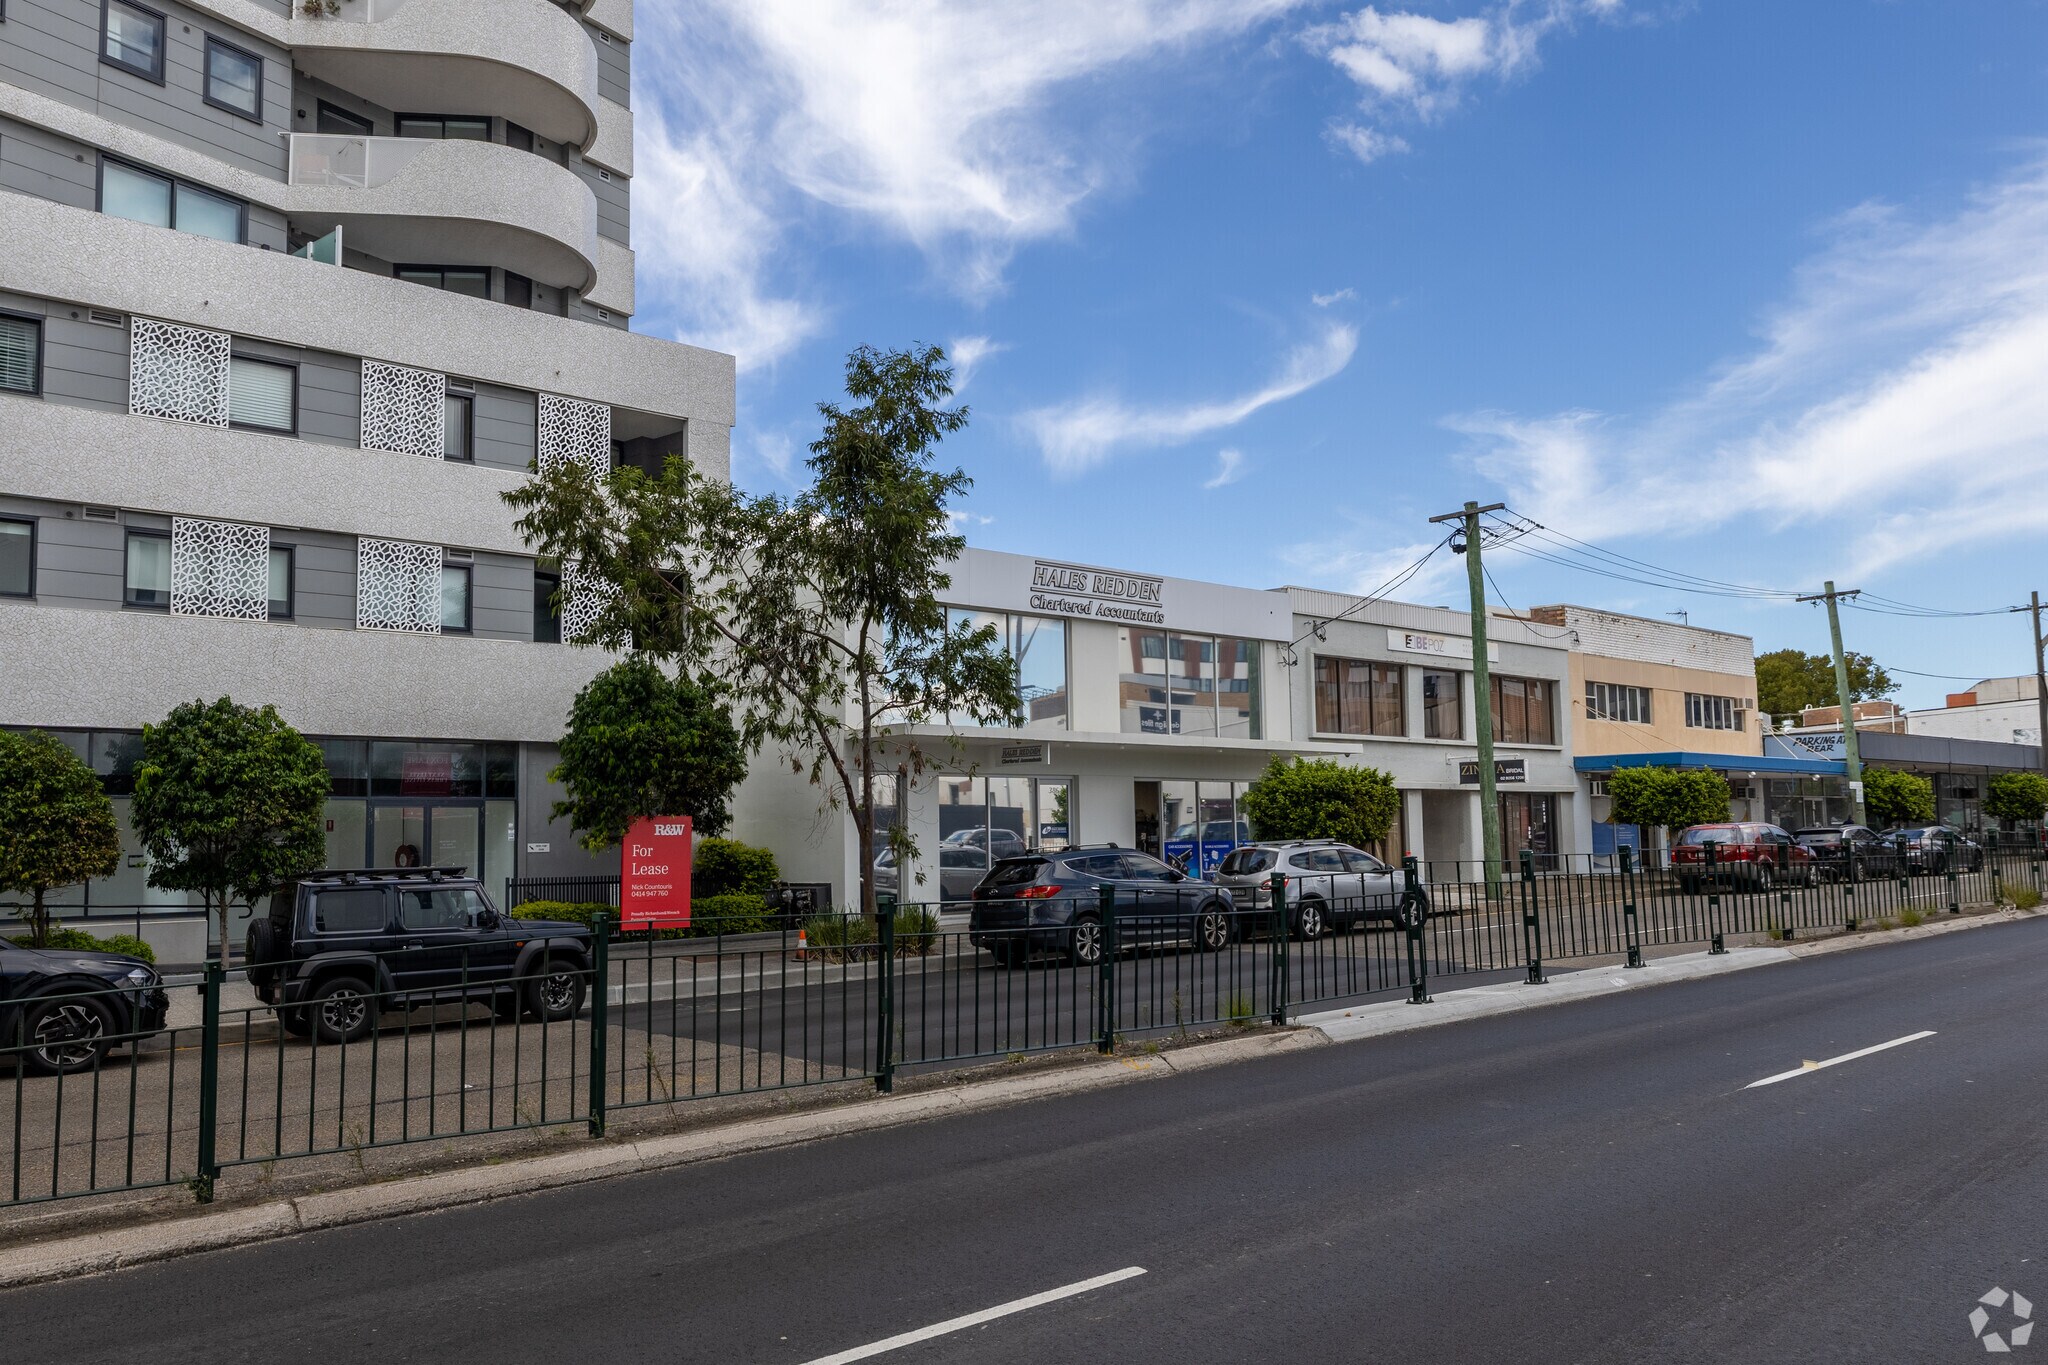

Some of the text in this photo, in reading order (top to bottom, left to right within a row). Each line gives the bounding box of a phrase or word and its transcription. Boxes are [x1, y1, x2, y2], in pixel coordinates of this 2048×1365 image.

[1033, 567, 1161, 601] HALES REDDEN
[1030, 595, 1164, 624] Chartered Accountants
[1792, 736, 1836, 746] PARKING
[1806, 744, 1834, 752] REAR
[1461, 764, 1505, 776] ZINA
[654, 824, 685, 835] R&W
[632, 845, 653, 856] For
[632, 863, 668, 875] Lease
